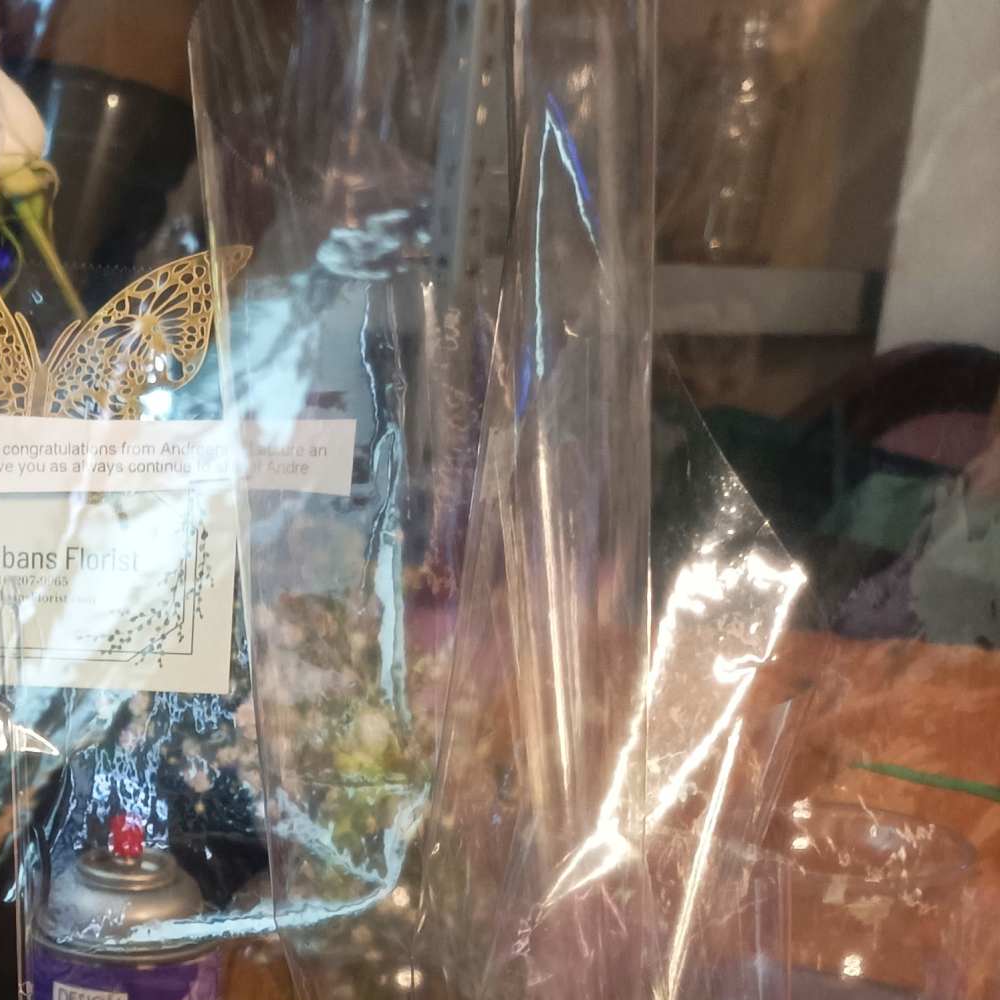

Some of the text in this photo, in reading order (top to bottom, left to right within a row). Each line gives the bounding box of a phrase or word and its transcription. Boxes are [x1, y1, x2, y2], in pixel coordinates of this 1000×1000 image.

[121, 441, 156, 455] from
[309, 445, 328, 457] an
[18, 463, 46, 477] you
[50, 463, 68, 473] as
[128, 460, 191, 474] continue
[65, 546, 141, 573] Florist
